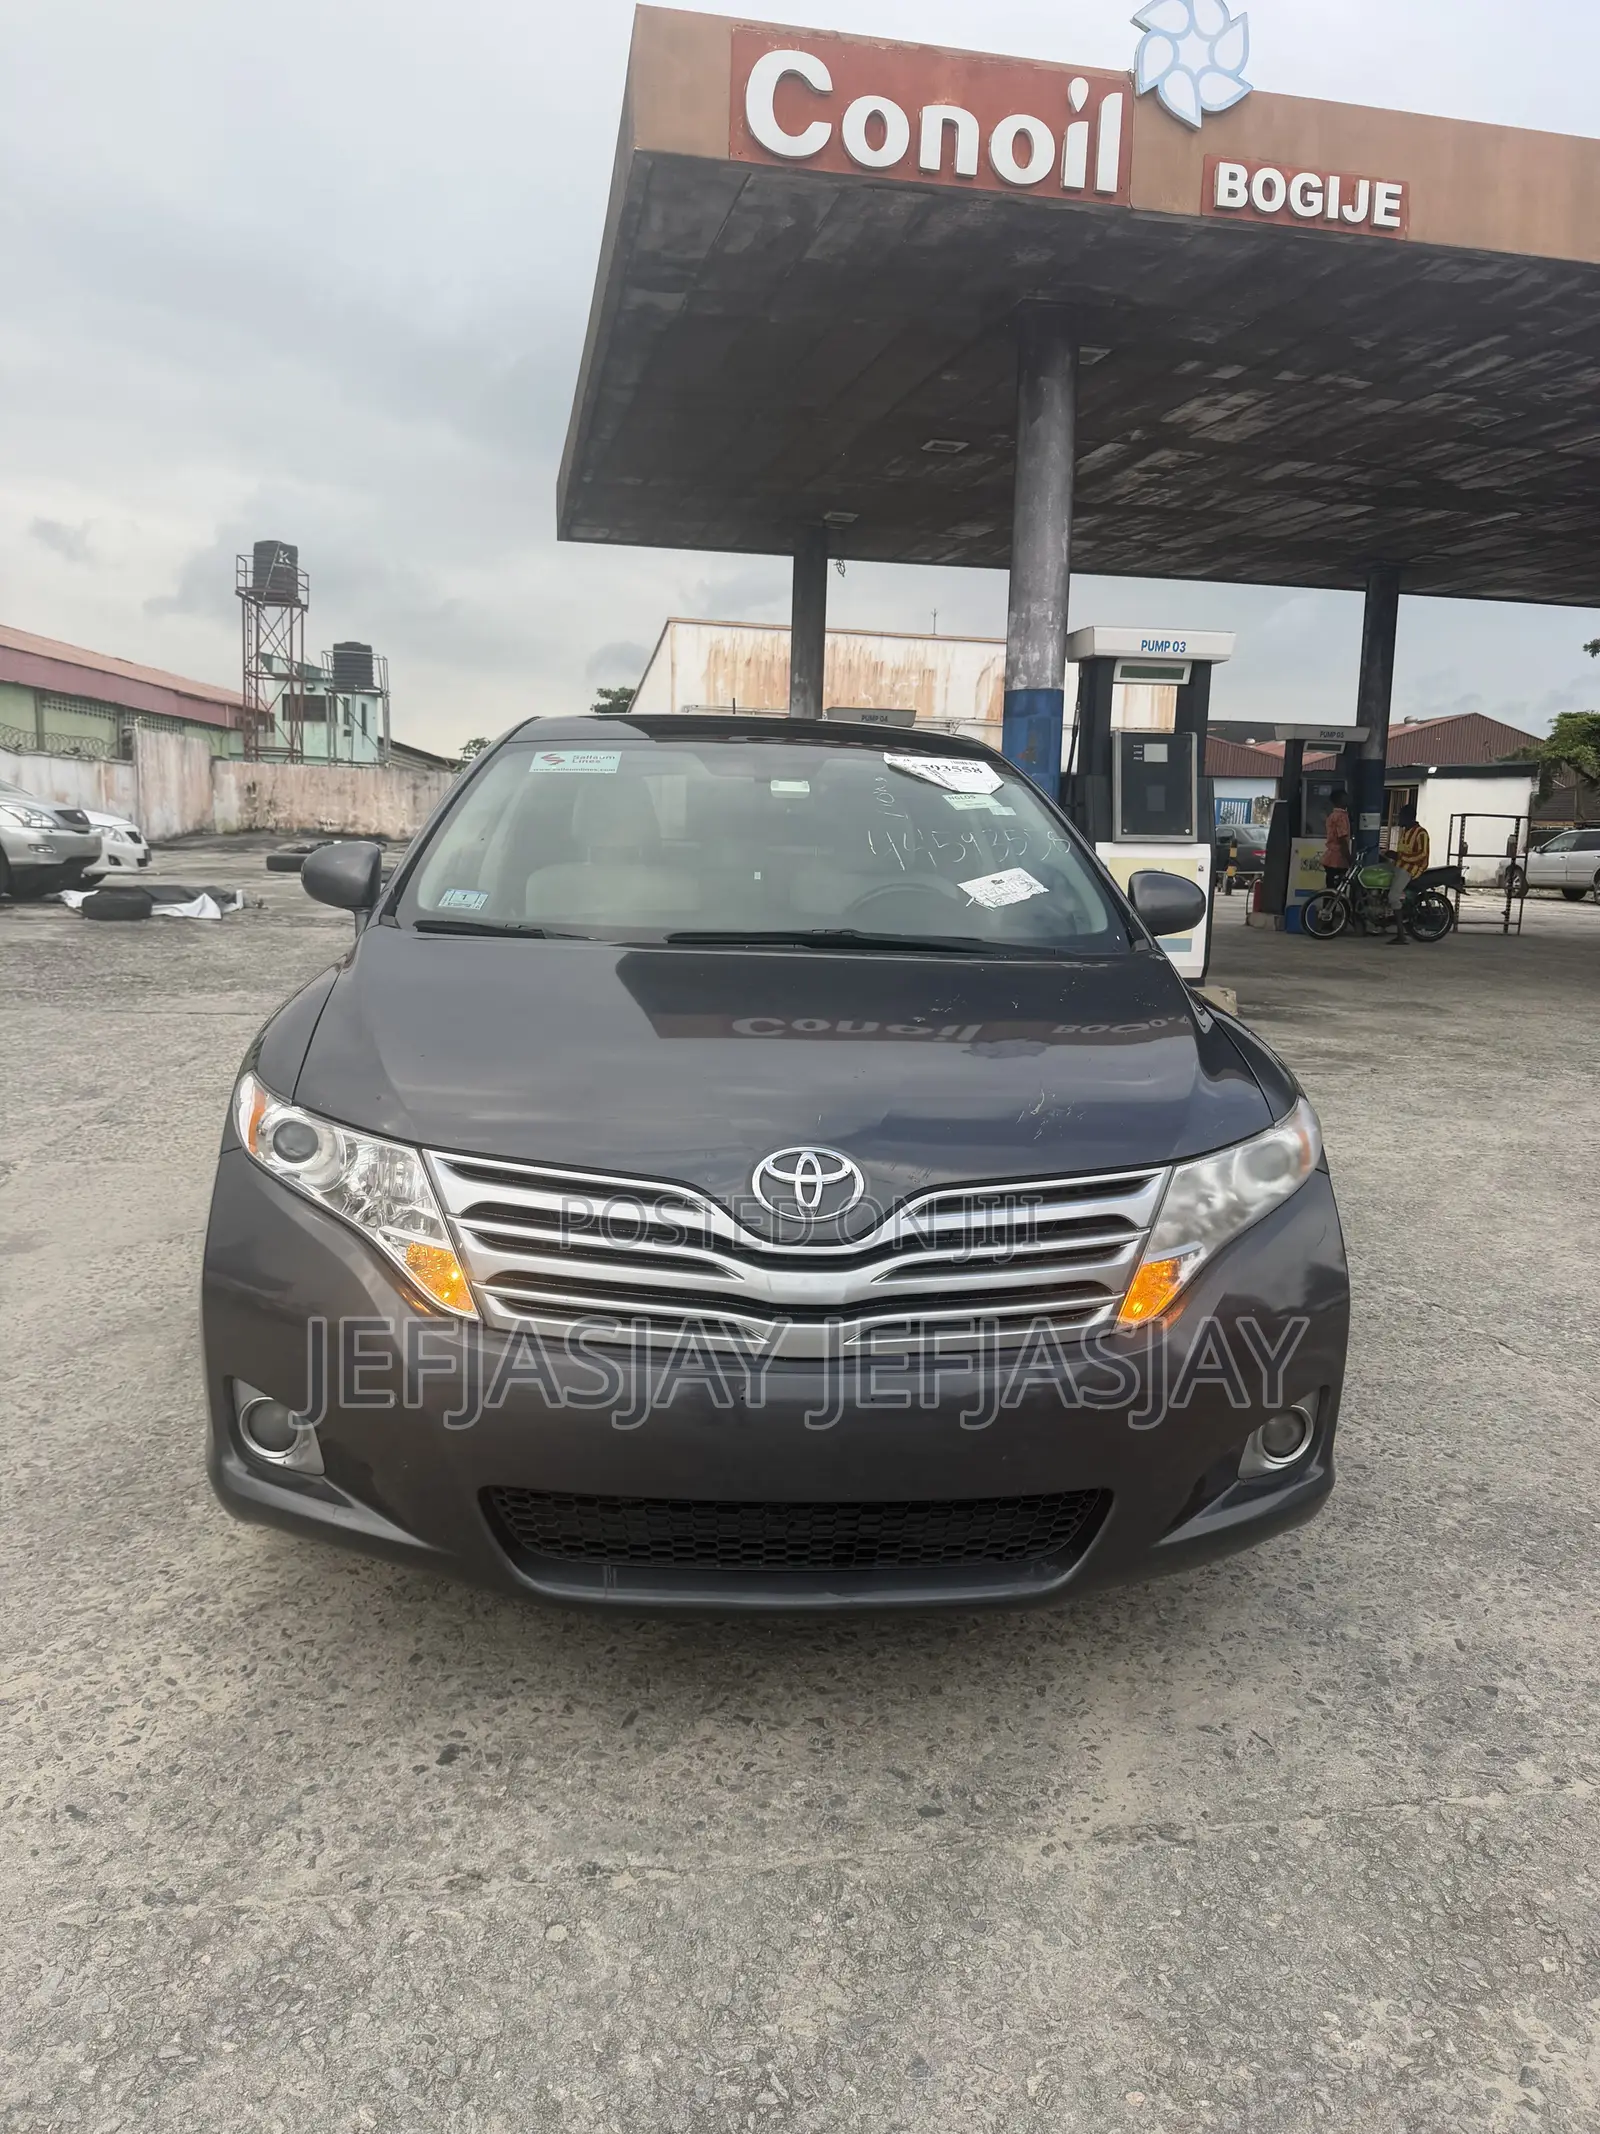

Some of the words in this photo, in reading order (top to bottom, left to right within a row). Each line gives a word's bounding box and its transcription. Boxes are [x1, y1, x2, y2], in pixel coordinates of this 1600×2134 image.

[744, 48, 1124, 195] Conoil
[1213, 161, 1403, 230] BOGIJE
[1140, 639, 1171, 653] PUMP
[1172, 640, 1187, 653] 03
